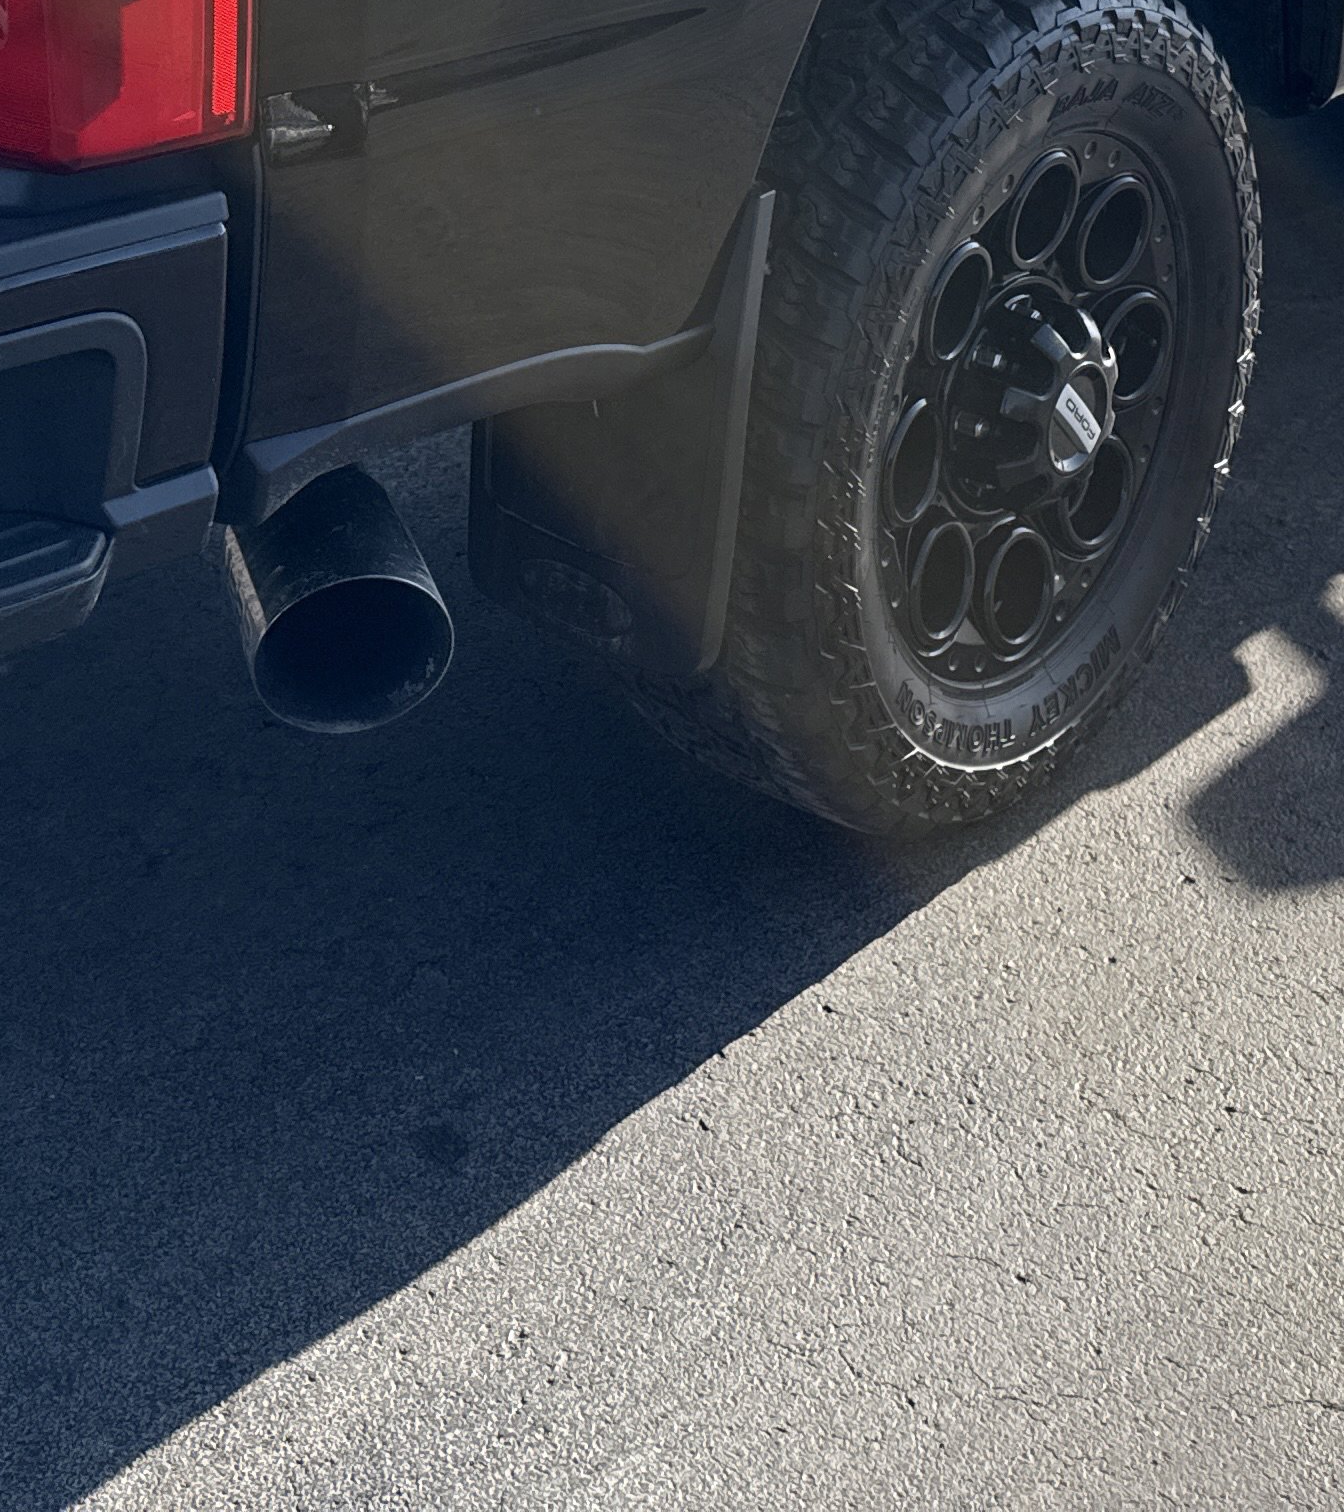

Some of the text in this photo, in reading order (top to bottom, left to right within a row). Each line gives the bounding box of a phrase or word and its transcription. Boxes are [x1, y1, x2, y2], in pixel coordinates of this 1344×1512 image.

[1047, 78, 1120, 122] BAJA
[1065, 398, 1096, 441] FORD
[896, 623, 1122, 756] MICKEY THOMPSON
